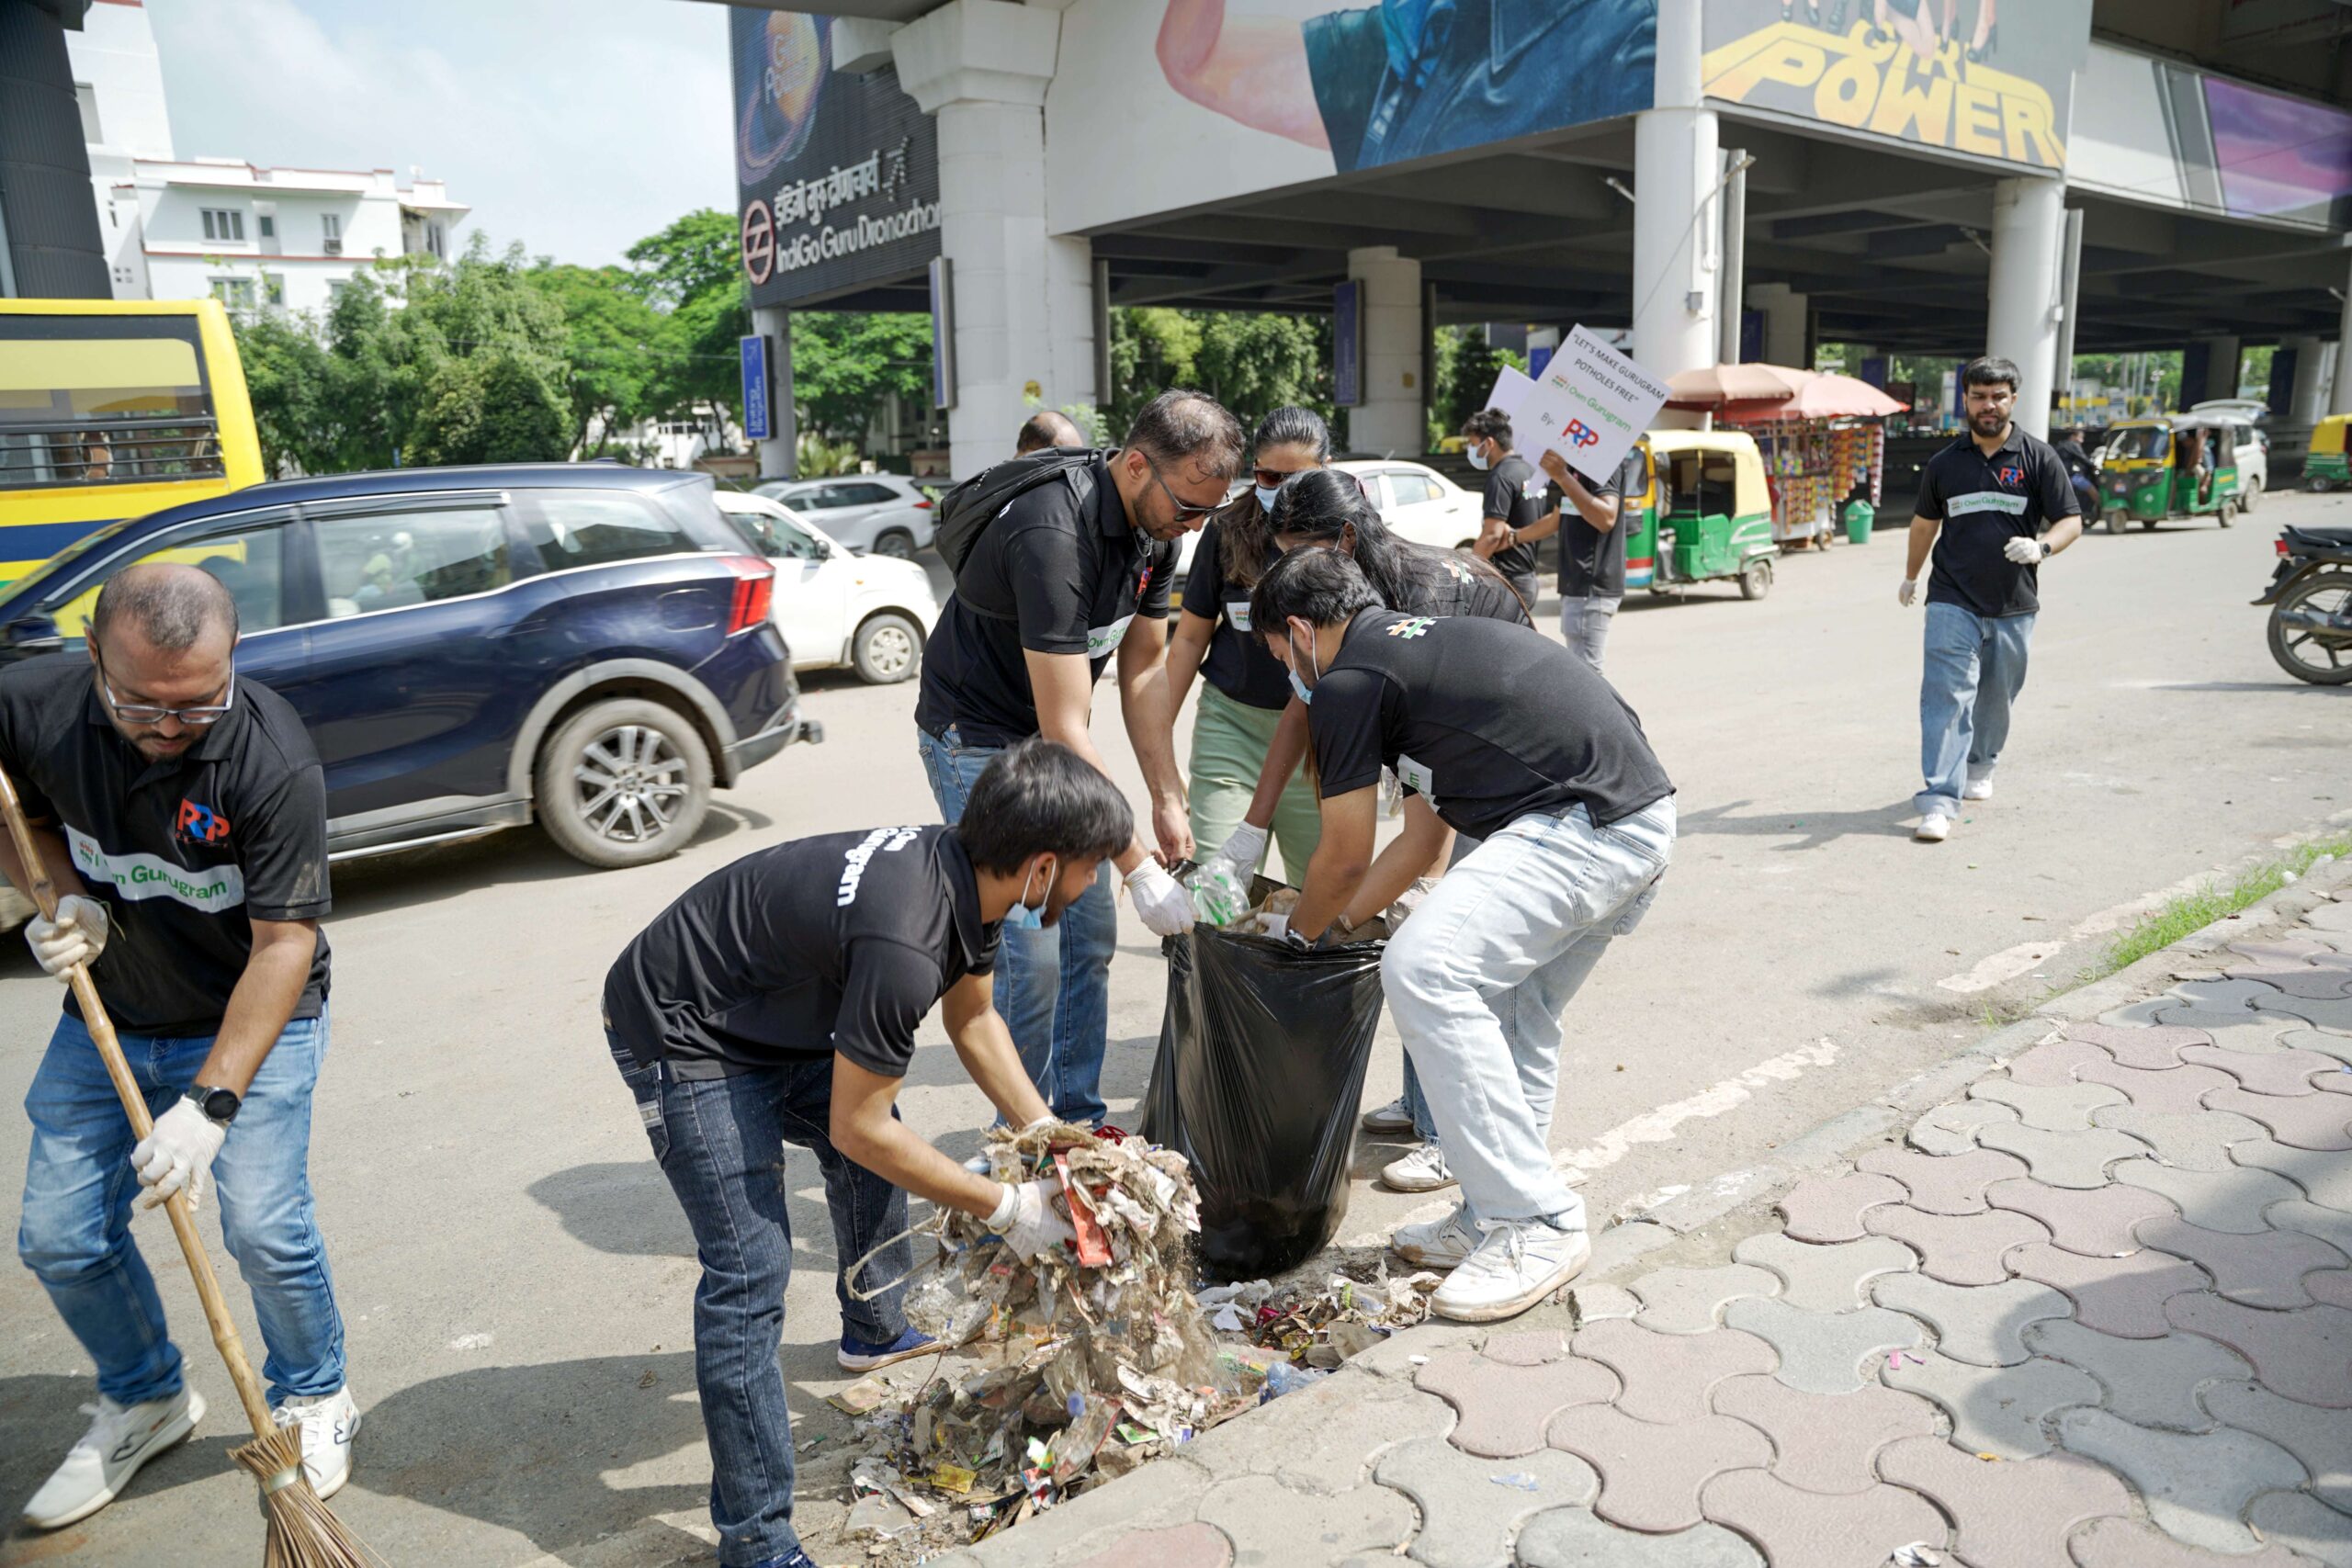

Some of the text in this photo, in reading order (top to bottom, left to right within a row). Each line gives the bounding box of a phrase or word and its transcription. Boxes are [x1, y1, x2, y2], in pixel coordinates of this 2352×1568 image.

[1702, 33, 2067, 169] POWER
[775, 233, 820, 274] IndiGo
[820, 225, 858, 259] Guru
[1574, 358, 1615, 389] POTHOLES
[1595, 349, 1620, 369] MAKE
[1618, 365, 1665, 400] GURUGRAM
[1568, 386, 1588, 403] Own
[1587, 397, 1632, 433] Gurugram
[130, 864, 227, 899] Gurugram
